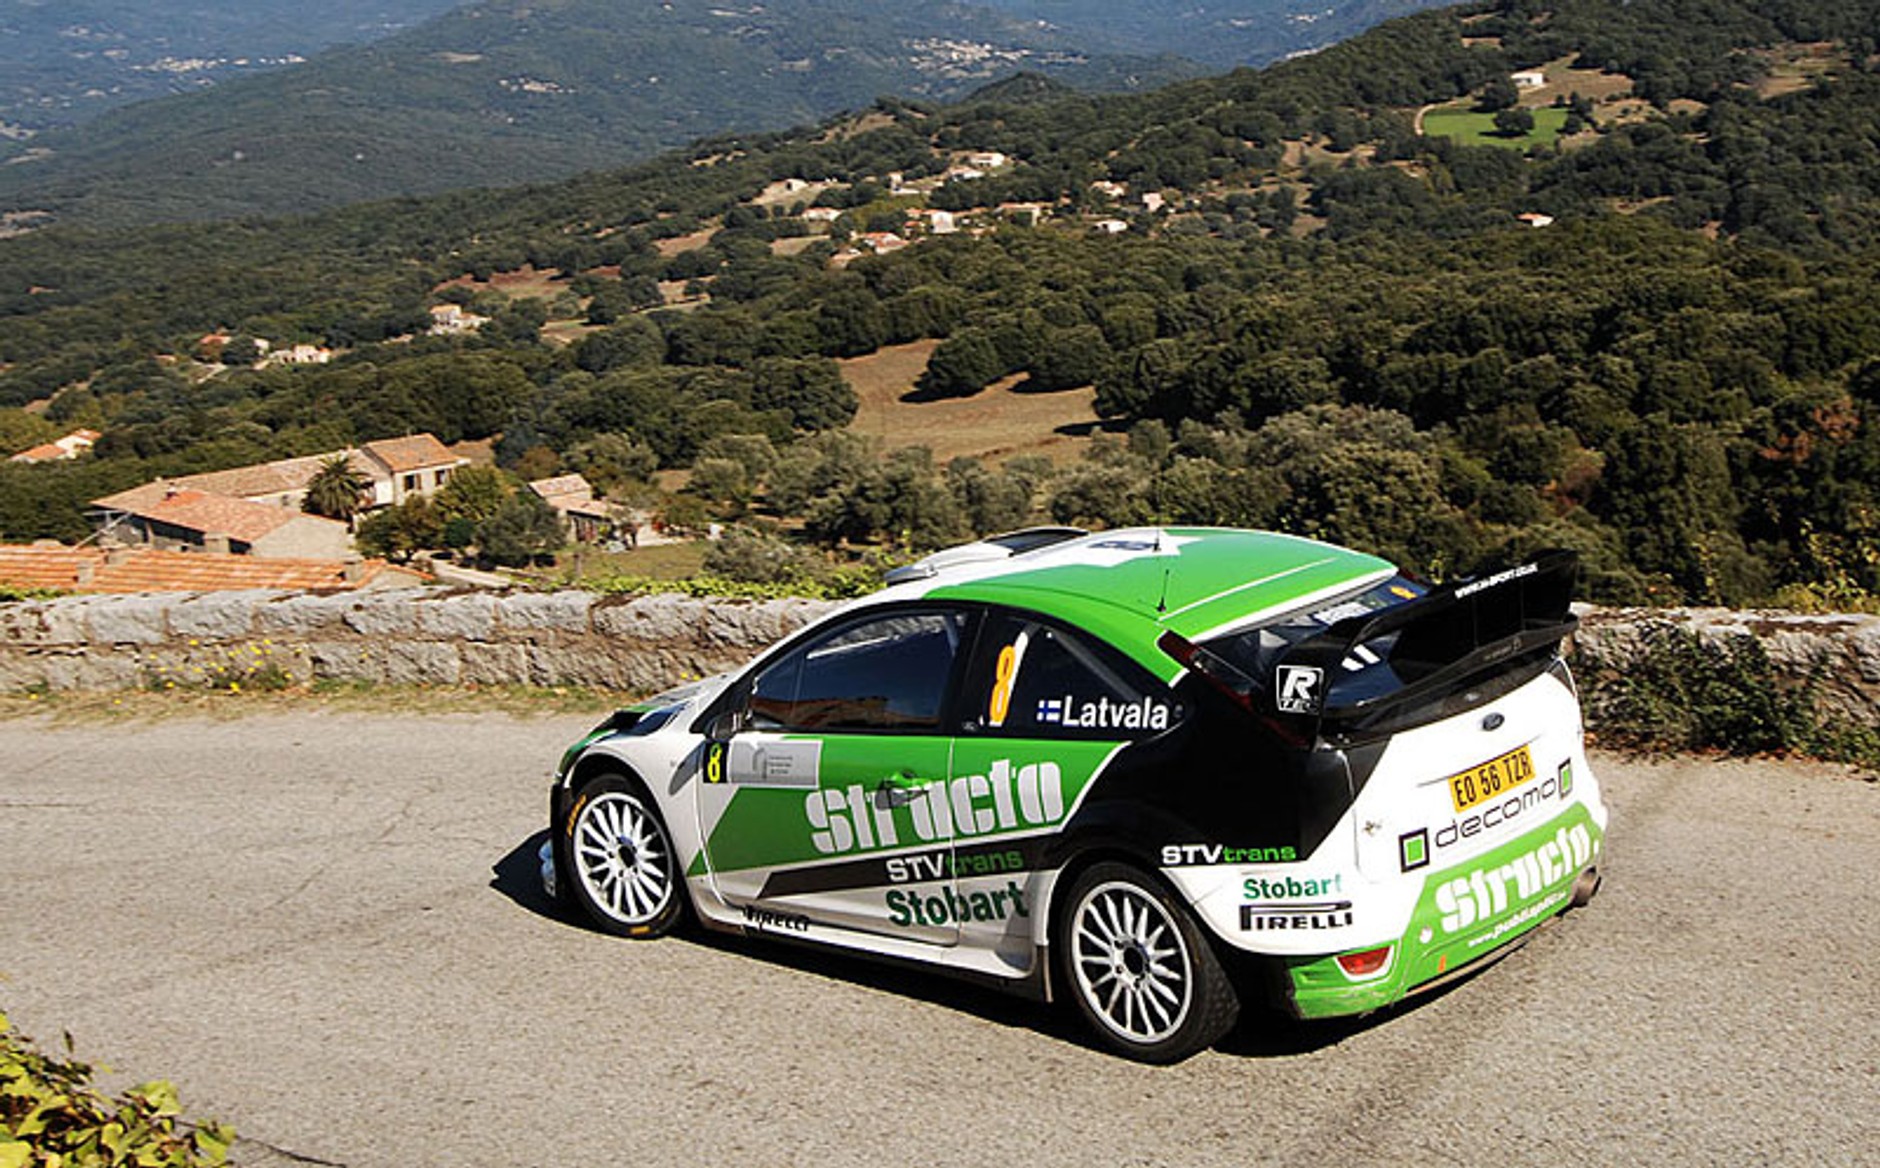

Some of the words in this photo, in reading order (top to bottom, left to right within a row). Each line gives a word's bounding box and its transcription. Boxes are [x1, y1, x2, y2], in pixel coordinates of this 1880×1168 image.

[990, 645, 1017, 724] 8
[1281, 669, 1318, 700] R
[1062, 695, 1169, 729] Latvala
[707, 743, 722, 783] 8
[1479, 763, 1501, 796] 56
[1502, 750, 1532, 785] TZR
[805, 759, 1065, 854] Structo
[1435, 777, 1557, 848] decomo
[885, 880, 1030, 927] Stobart
[1242, 872, 1342, 900] Stobart
[1239, 900, 1353, 931] PIRELLI
